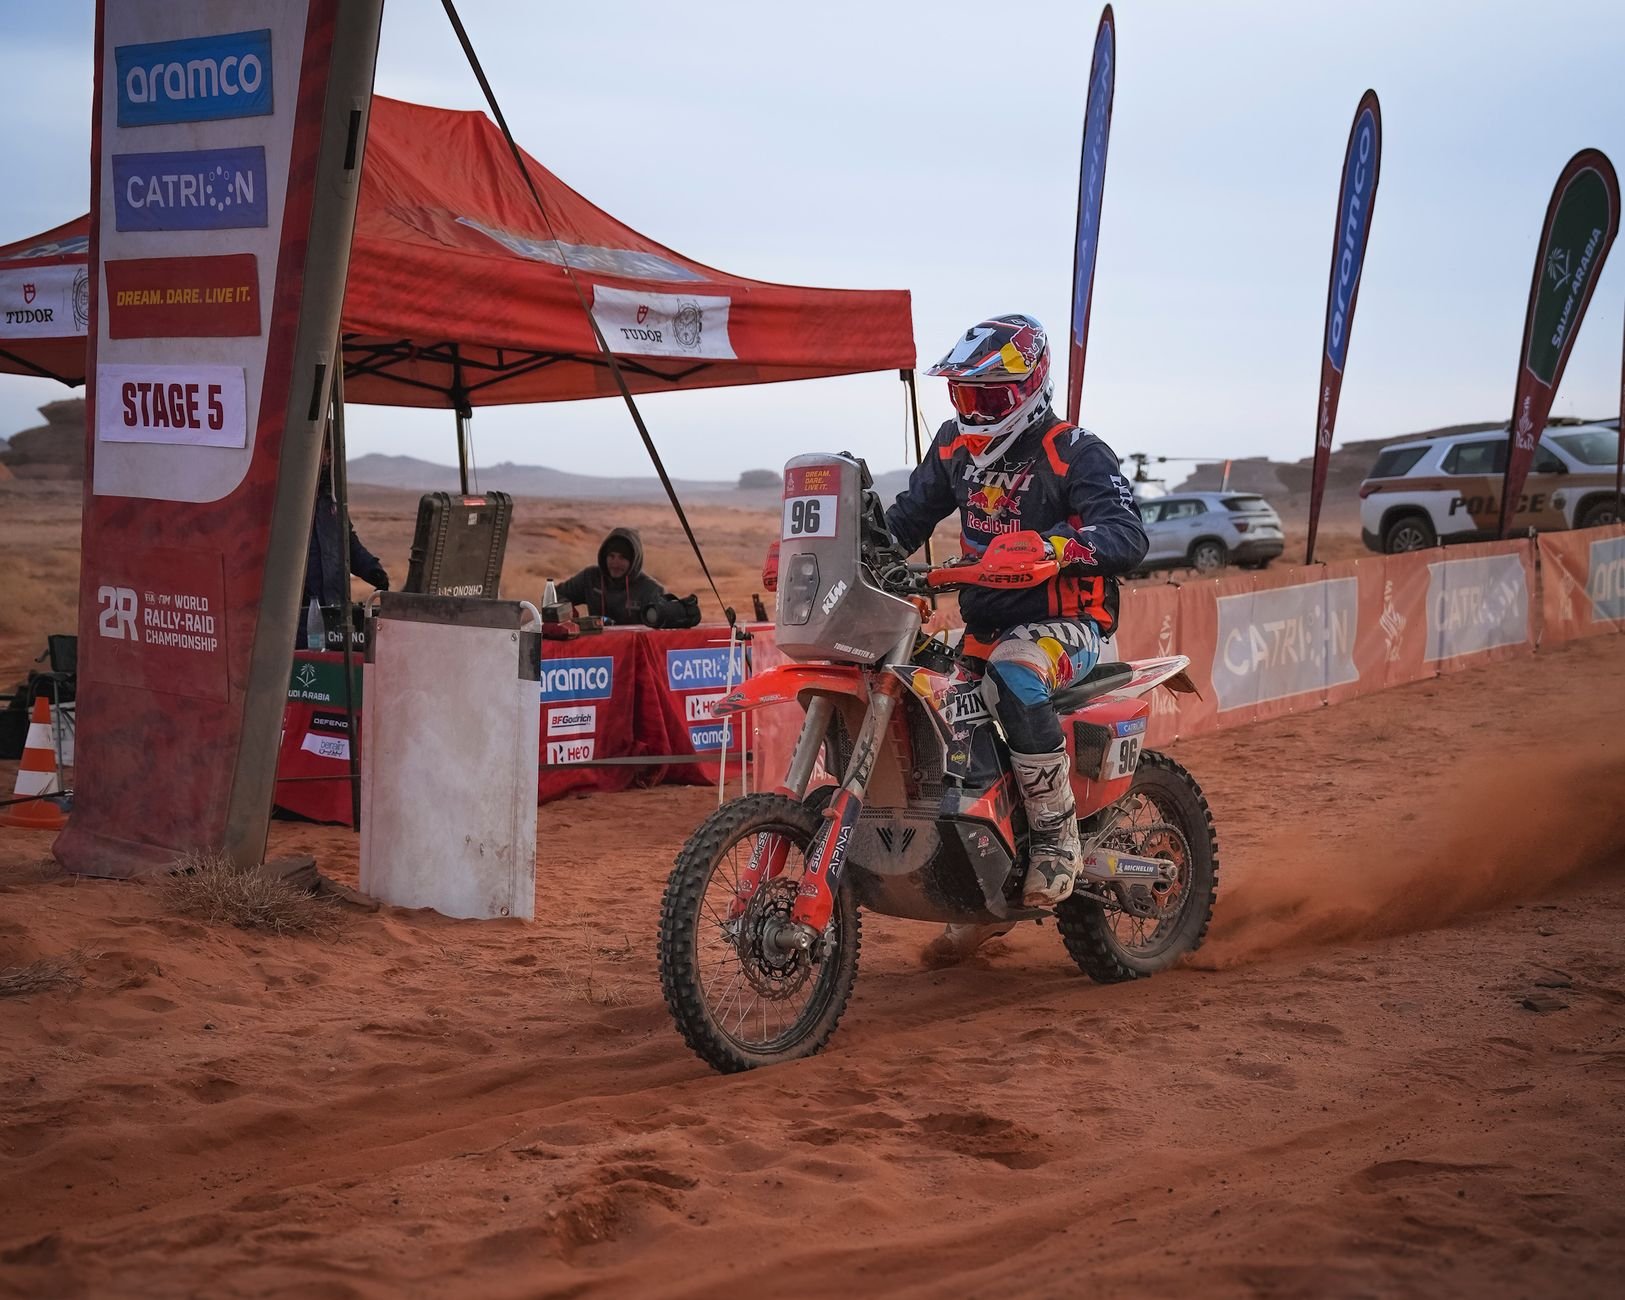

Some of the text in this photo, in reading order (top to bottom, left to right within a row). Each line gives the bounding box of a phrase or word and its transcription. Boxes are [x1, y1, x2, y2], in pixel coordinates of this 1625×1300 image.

[126, 54, 262, 103] aramco
[1331, 126, 1371, 349] aramco
[116, 286, 251, 307] DREAM. DARE. LIVE IT.
[1551, 226, 1602, 350] SAUDI ARABIA
[6, 307, 54, 324] TUDOR
[620, 327, 663, 344] TUDOR
[122, 381, 224, 431] STAGE 5
[805, 470, 831, 478] DREAM.
[962, 464, 1034, 491] KINI
[791, 499, 820, 534] 96
[1448, 493, 1546, 517] POLCE
[966, 510, 1021, 534] Red Bull
[977, 573, 1034, 583] ACERBIS
[1592, 557, 1625, 602] ara
[453, 584, 483, 597] CHRONO
[821, 579, 848, 616] KTM
[174, 594, 214, 612] WORLD
[143, 607, 214, 635] RALLY-RAID
[145, 629, 218, 652] CHAMPIONSHIP
[327, 630, 365, 644] CHNO
[301, 690, 331, 702] ARABIA
[955, 691, 988, 717] KIN
[313, 717, 349, 728] DEFEND
[1118, 737, 1138, 775] 96
[1123, 863, 1154, 873] MICHELIN
